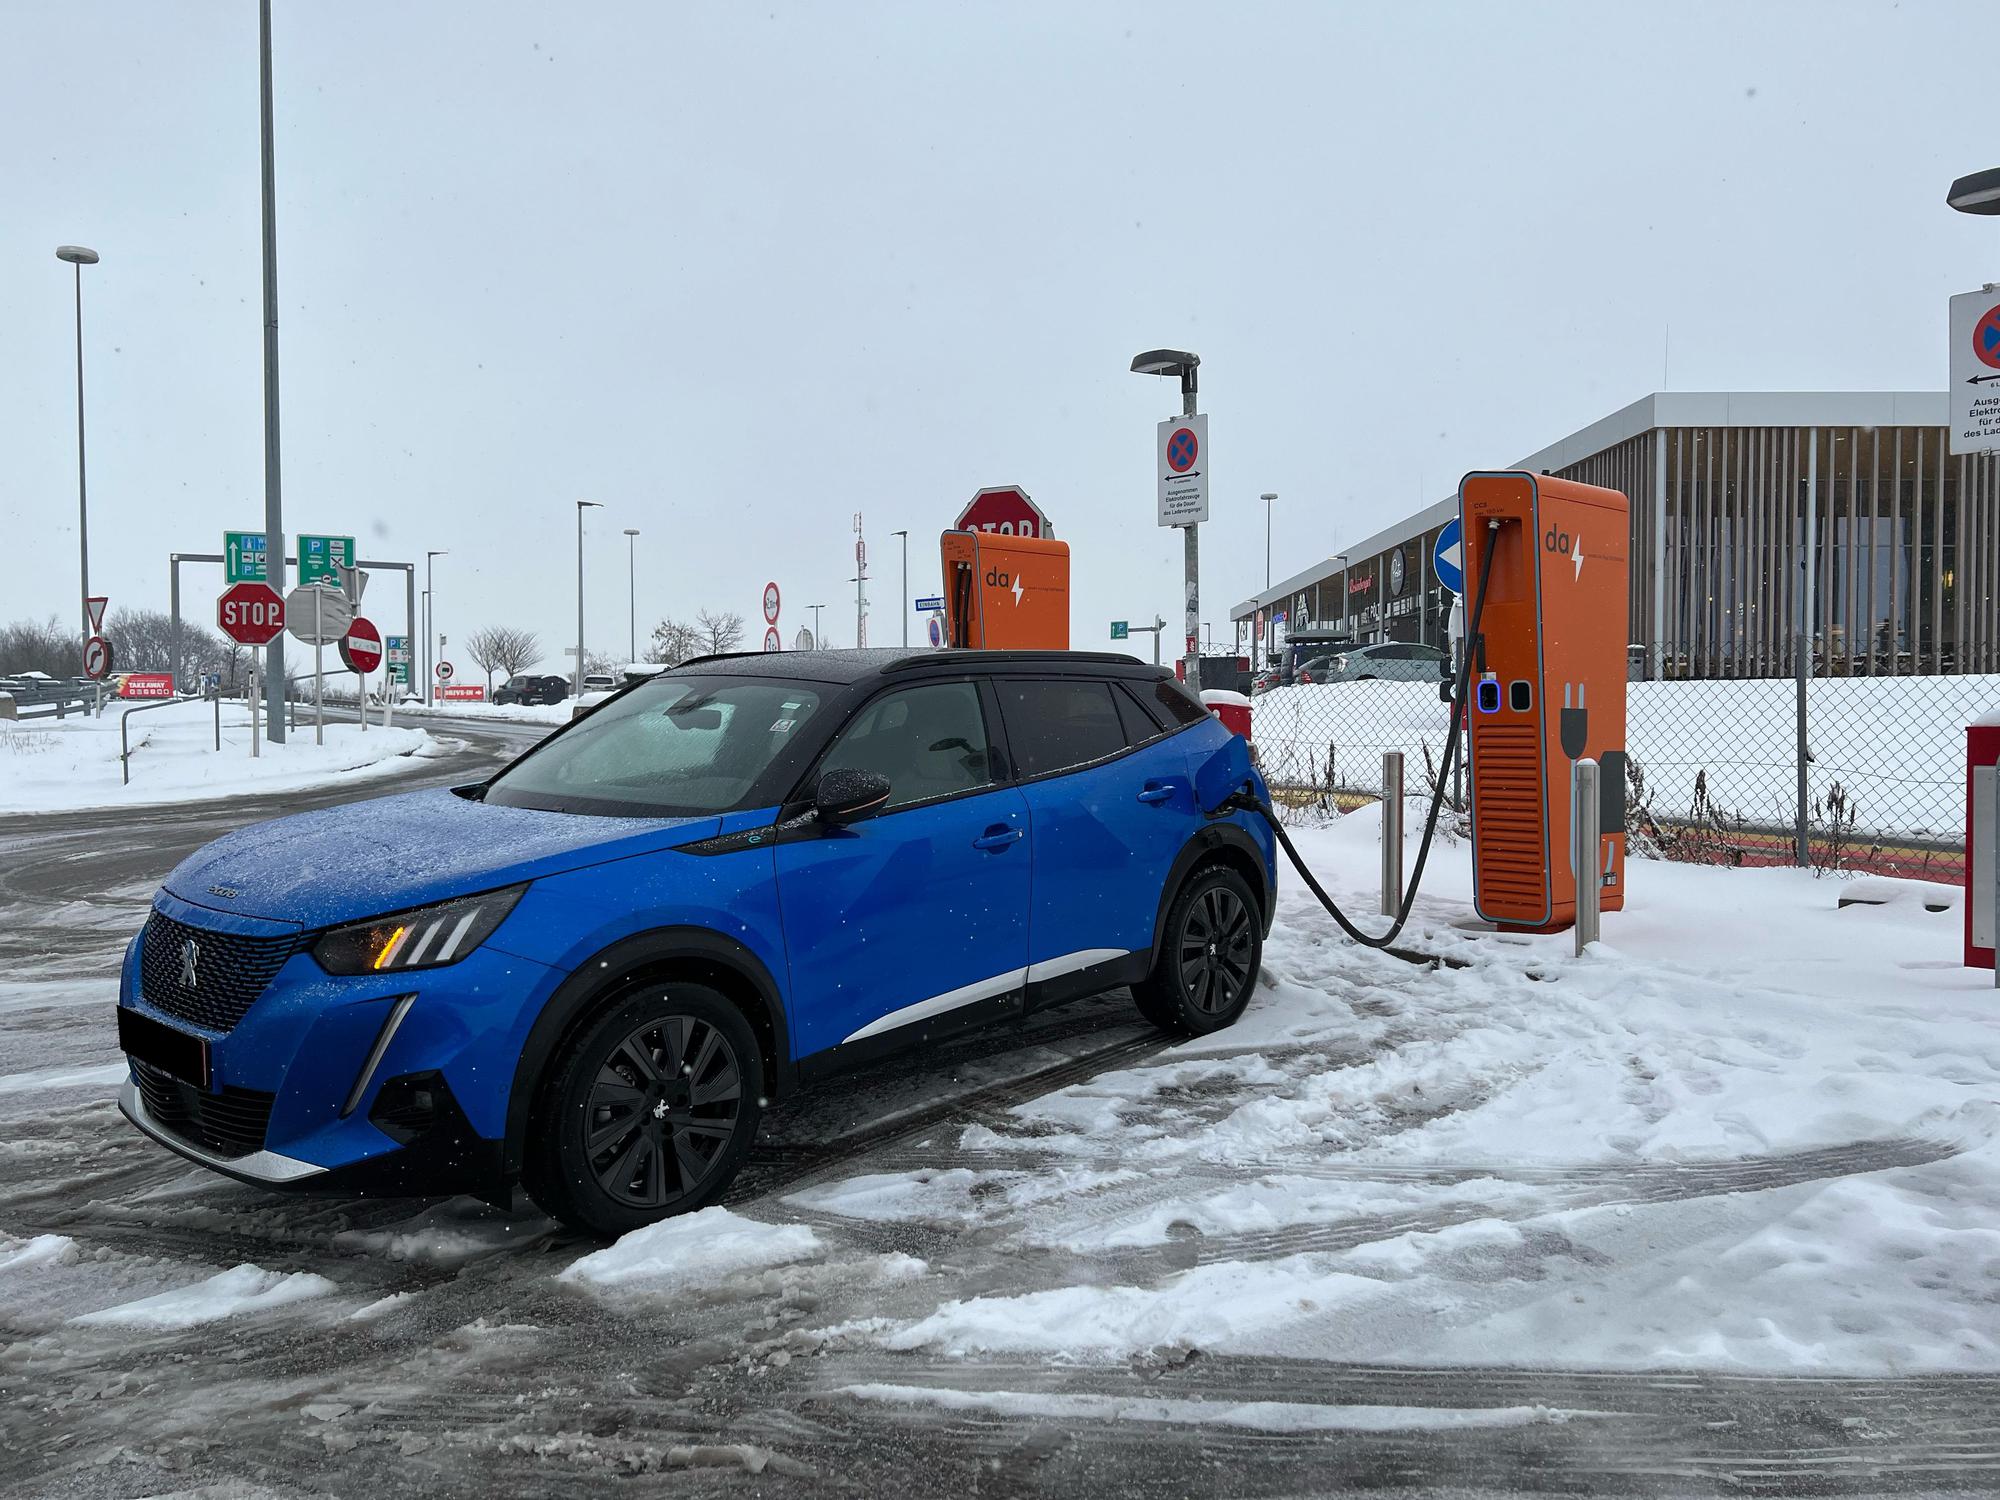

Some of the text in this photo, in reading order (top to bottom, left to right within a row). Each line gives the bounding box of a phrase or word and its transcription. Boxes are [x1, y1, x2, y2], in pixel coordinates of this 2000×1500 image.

[1973, 397, 2000, 407] Ausg
[1979, 417, 1993, 426] für
[1963, 430, 1981, 438] des
[1545, 522, 1569, 554] da
[986, 565, 1009, 588] da
[224, 601, 280, 626] STOP
